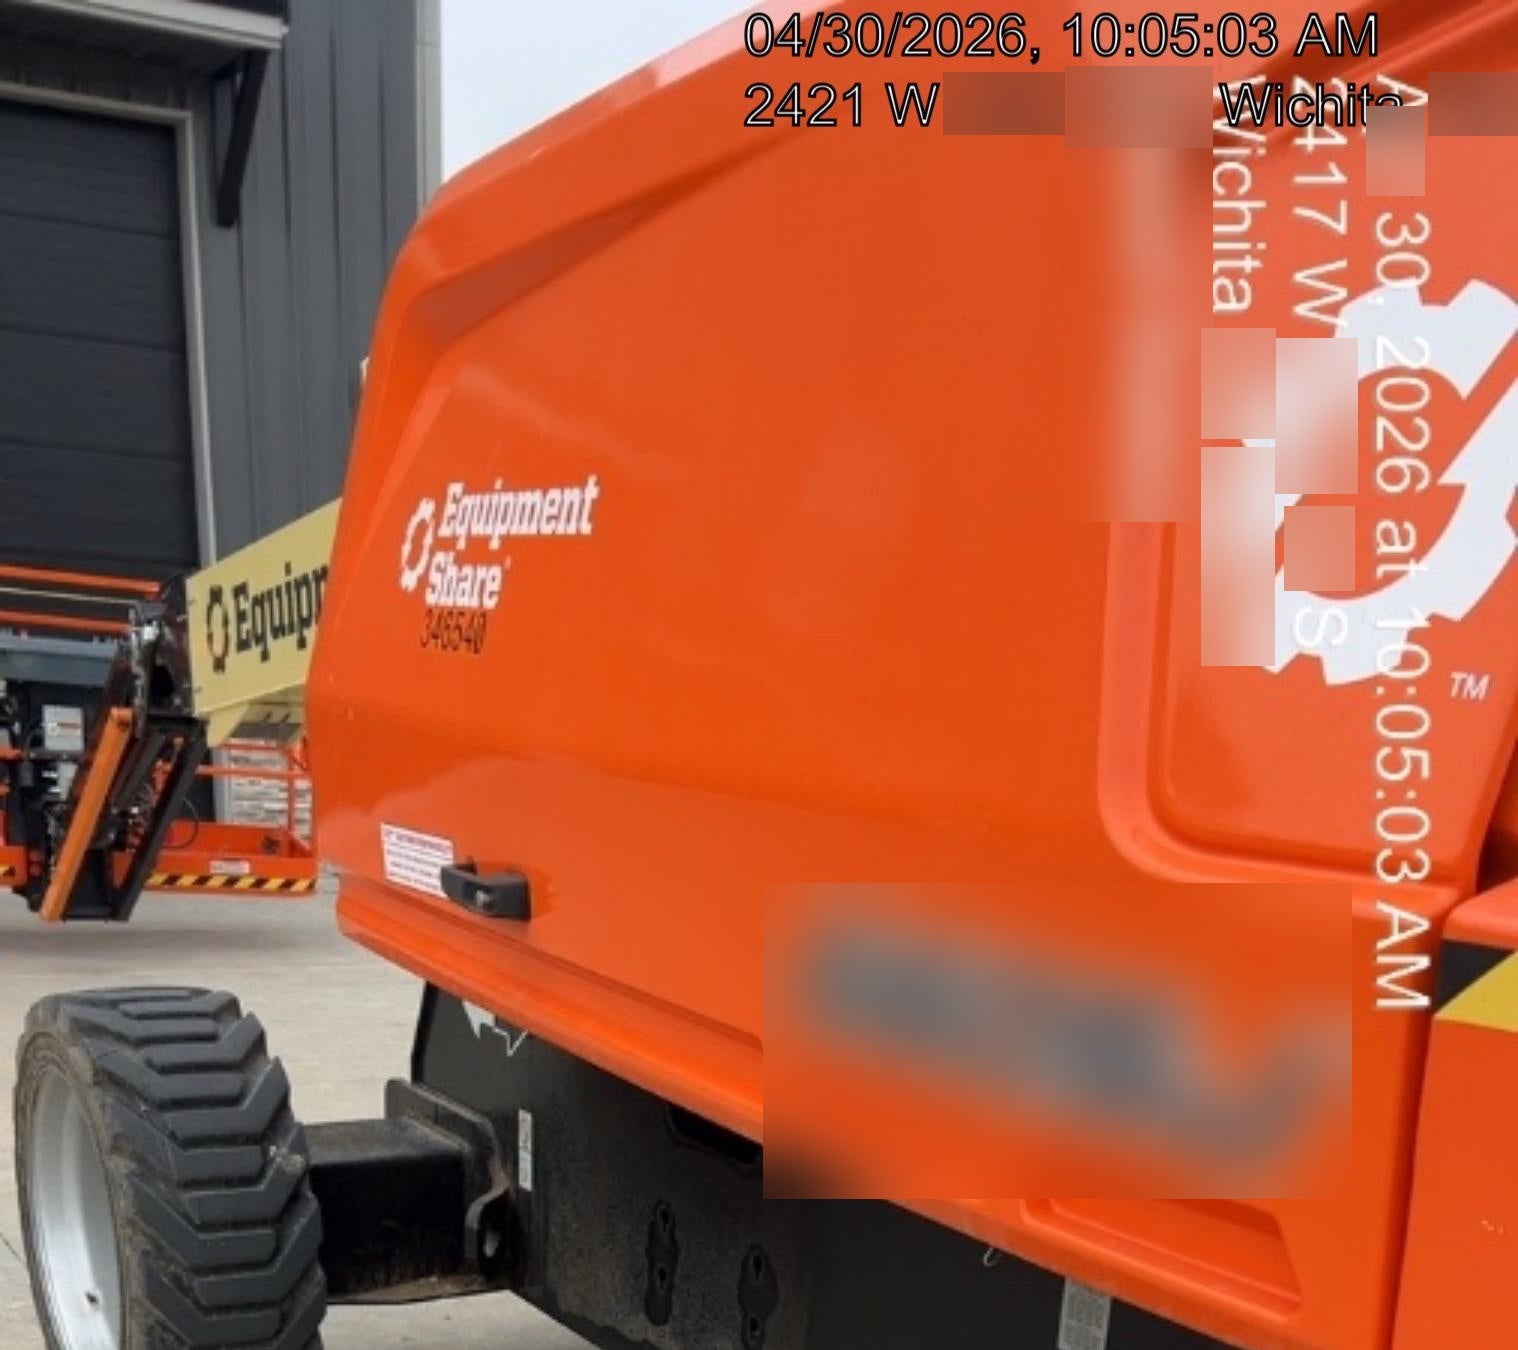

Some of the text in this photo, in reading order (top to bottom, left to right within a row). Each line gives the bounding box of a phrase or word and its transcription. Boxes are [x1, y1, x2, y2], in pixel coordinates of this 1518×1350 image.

[438, 474, 599, 551] Equipment
[425, 550, 503, 609] Share
[1449, 672, 1490, 700] TM
